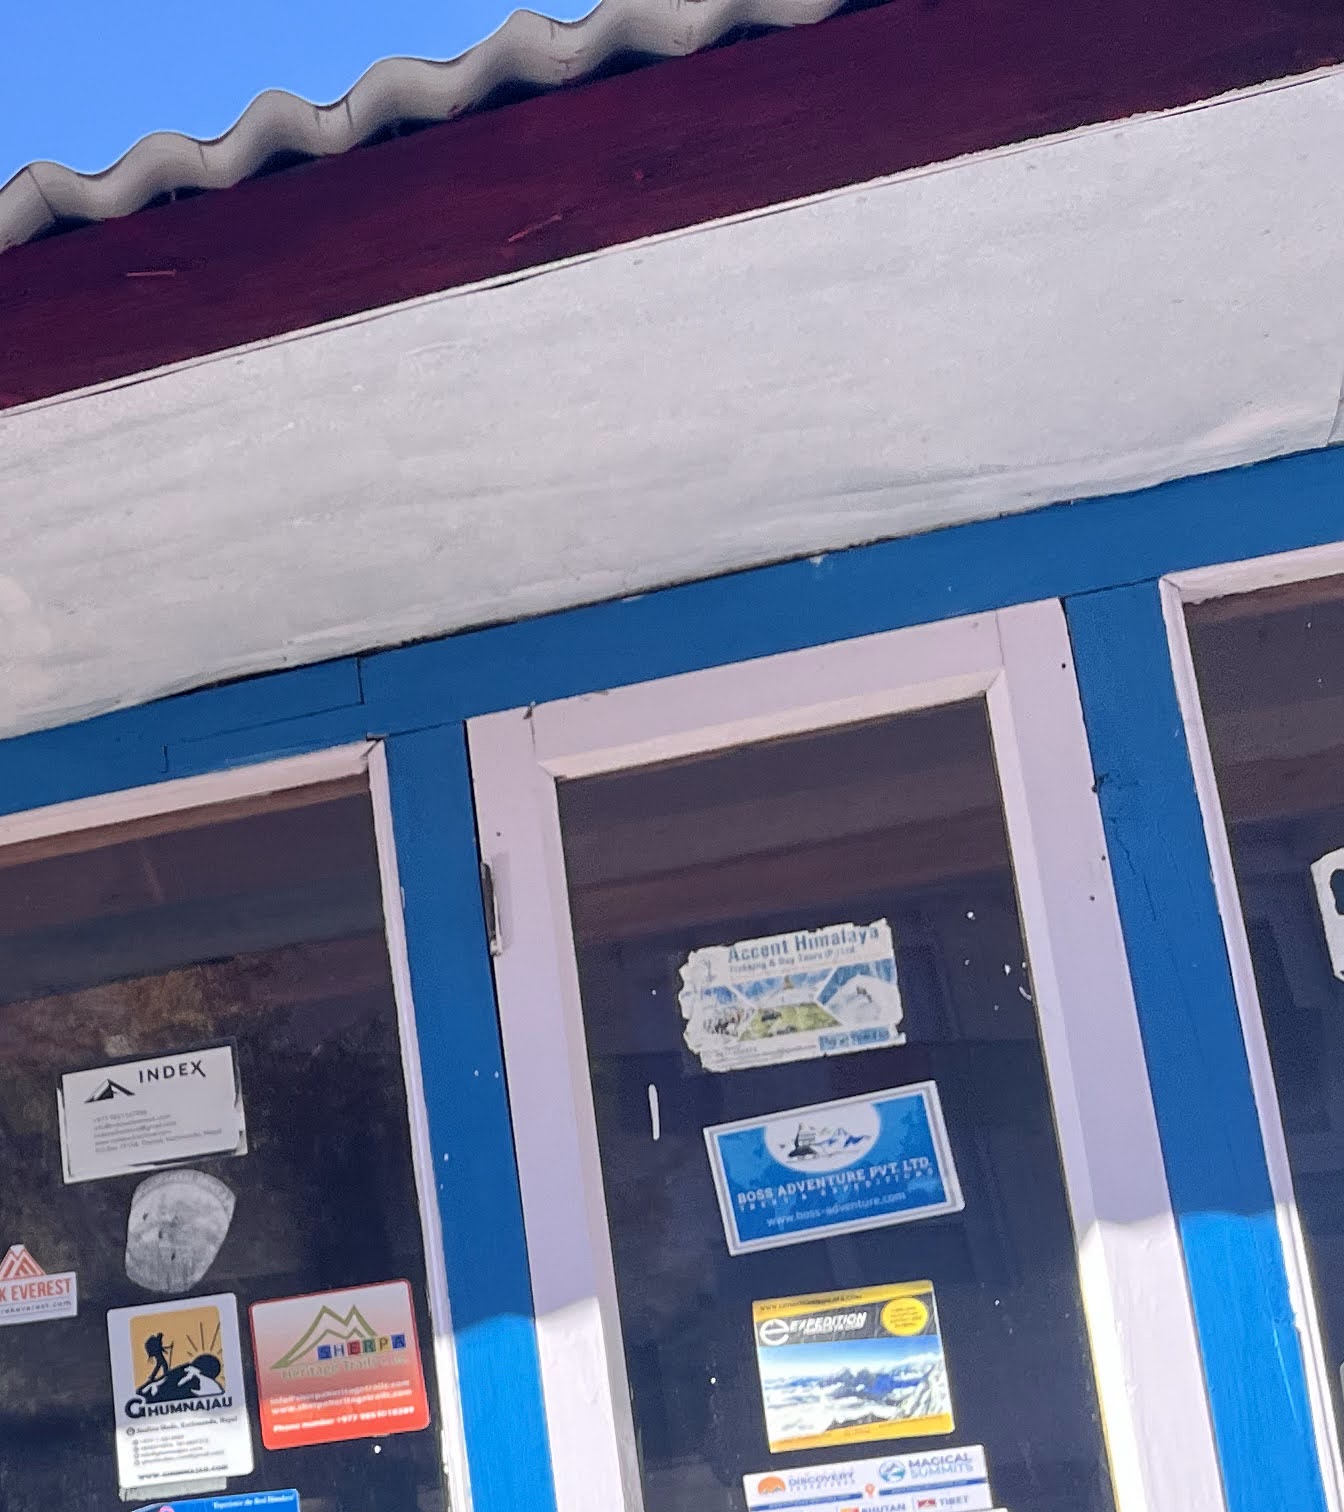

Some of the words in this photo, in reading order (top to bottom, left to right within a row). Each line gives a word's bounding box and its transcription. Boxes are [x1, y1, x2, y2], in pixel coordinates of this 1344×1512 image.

[139, 1060, 206, 1083] INDEX
[737, 1187, 773, 1205] BOSS
[778, 1170, 865, 1197] ADVENTURE
[11, 1278, 71, 1300] EVEREST
[318, 1335, 406, 1360] SHERPA
[125, 1396, 232, 1419] GHUMNAJAU
[909, 1453, 970, 1467] MAGICAL
